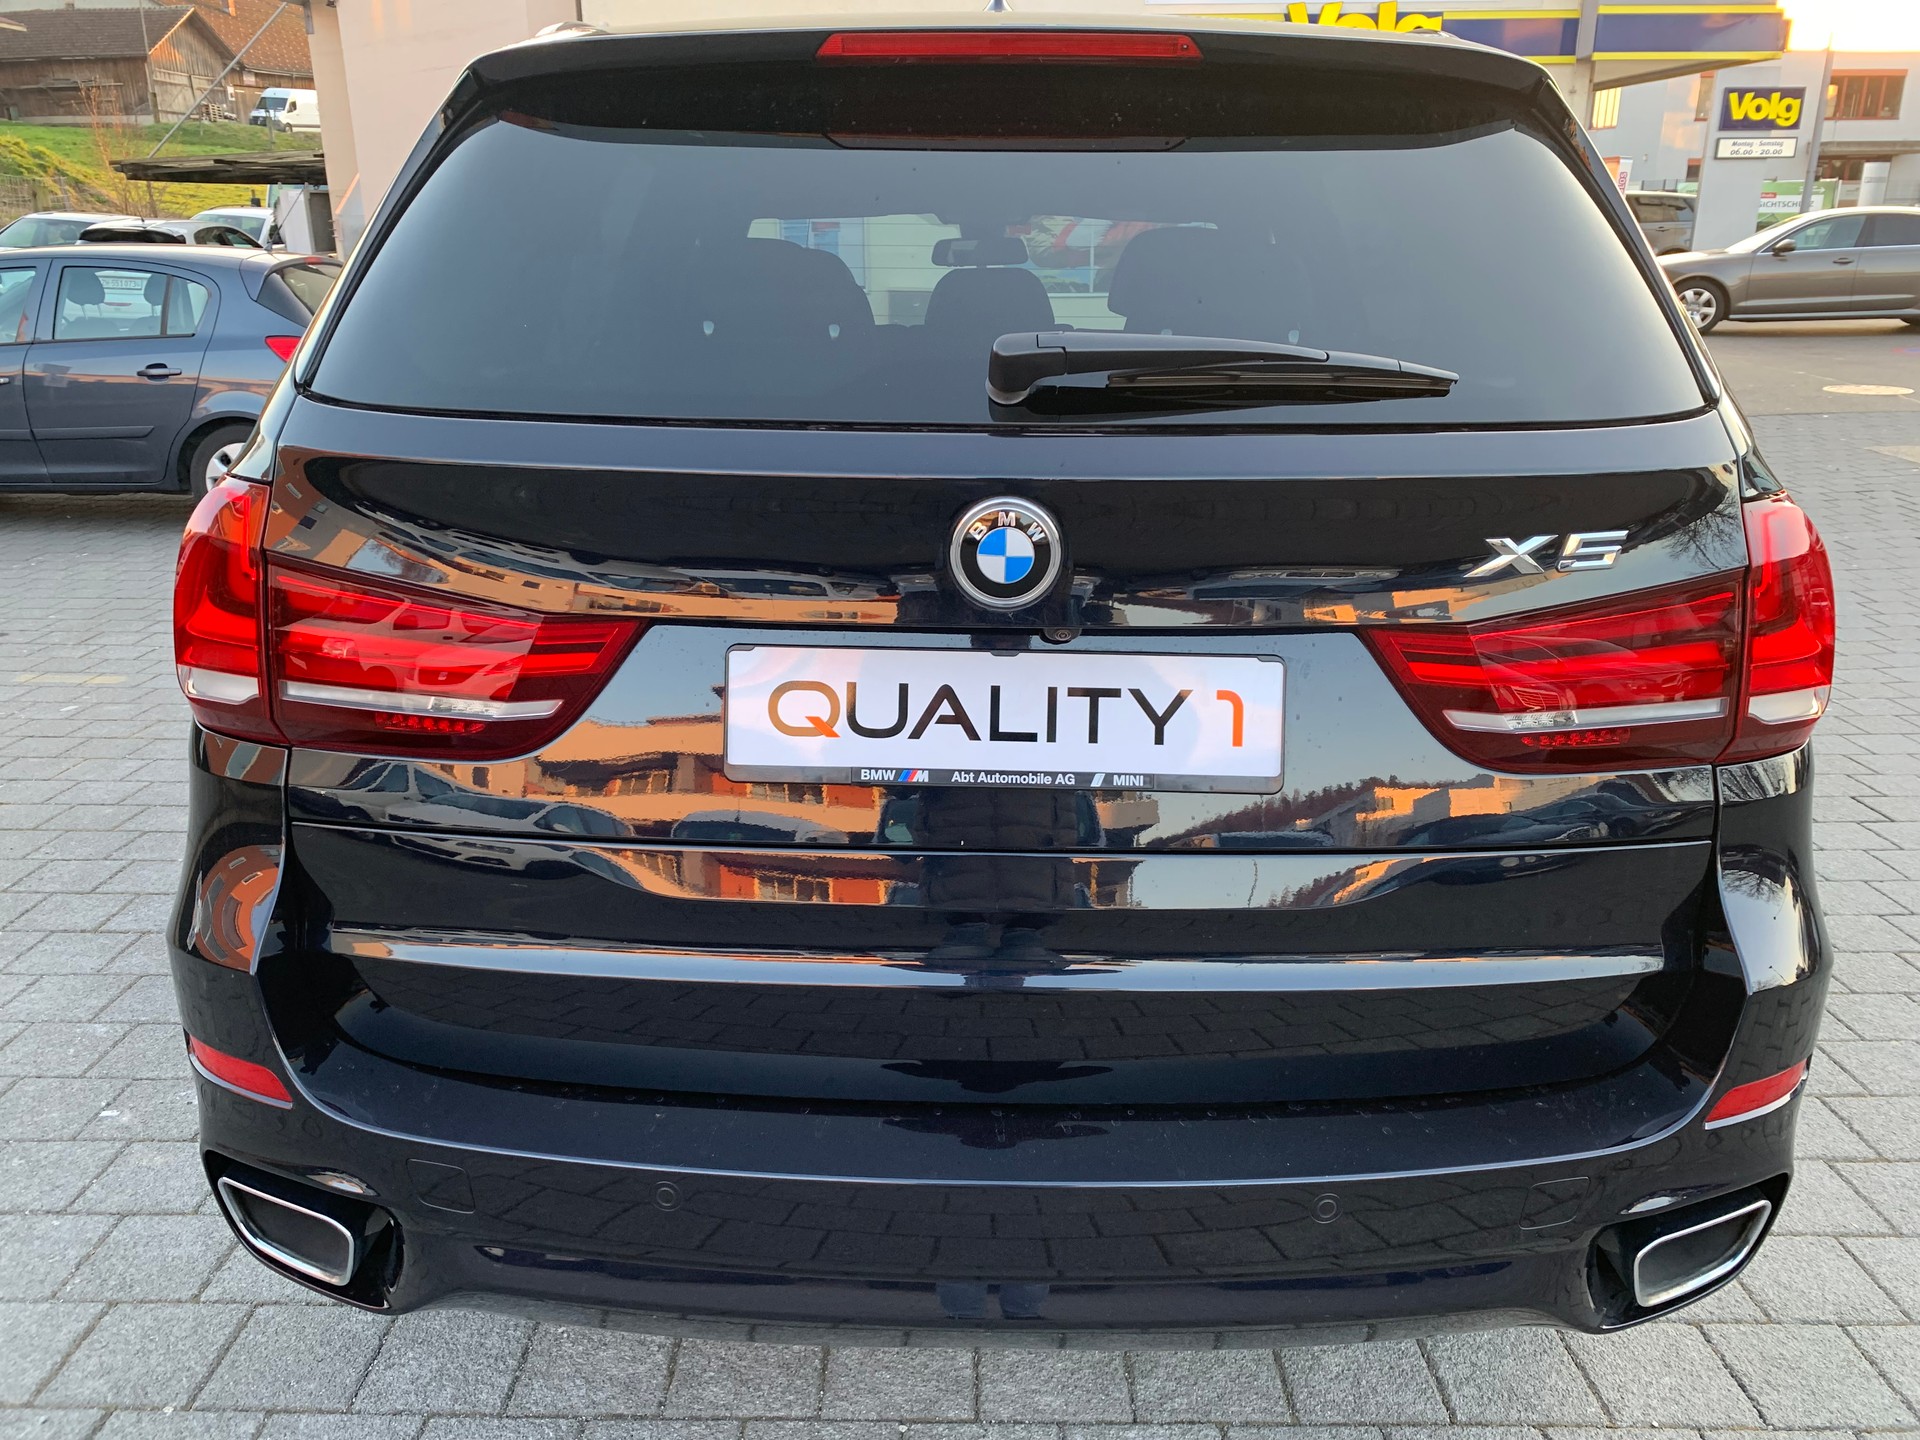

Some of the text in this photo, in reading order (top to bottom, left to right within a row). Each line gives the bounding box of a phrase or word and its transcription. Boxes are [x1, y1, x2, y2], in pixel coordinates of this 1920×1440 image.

[1728, 91, 1802, 127] Volg
[1758, 140, 1784, 148] Samstag
[1730, 148, 1753, 156] 06.00
[1759, 148, 1783, 156] 20.00
[968, 511, 1047, 542] BMW
[1463, 530, 1630, 578] X5
[767, 680, 1245, 748] QUALITY 1
[860, 769, 897, 781] BMW
[951, 771, 1076, 785] Abt Automobile AG
[1113, 774, 1144, 786] MINI
